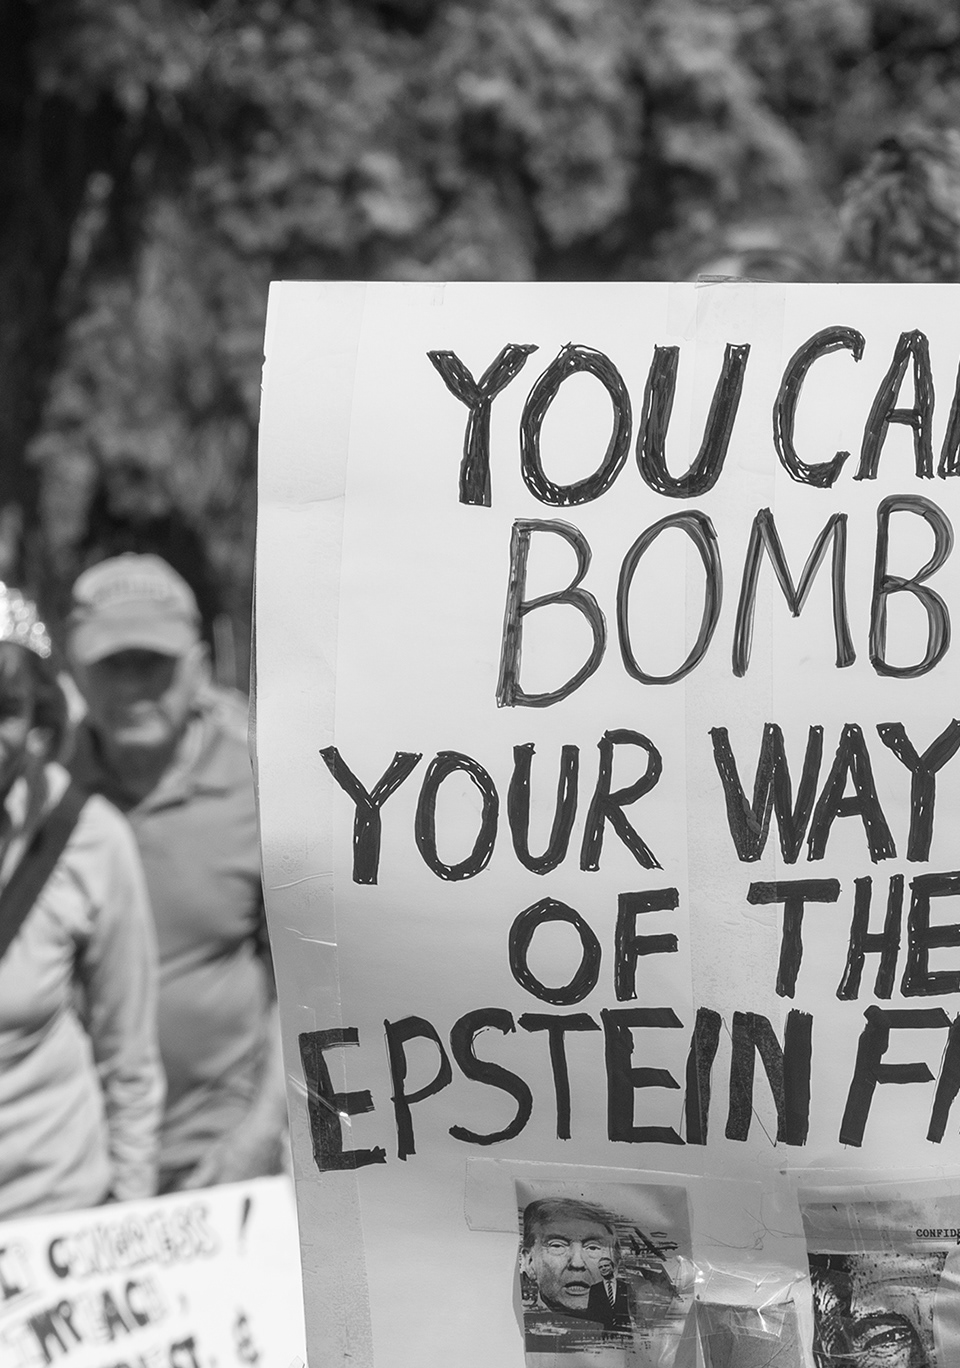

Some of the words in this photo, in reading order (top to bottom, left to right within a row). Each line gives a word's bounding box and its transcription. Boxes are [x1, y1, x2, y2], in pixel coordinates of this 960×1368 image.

[427, 342, 750, 507] YOU
[496, 494, 952, 708] BOMB
[319, 729, 664, 885] YOUR
[509, 888, 680, 1005] OF
[298, 1006, 813, 1172] EPSTEIN
